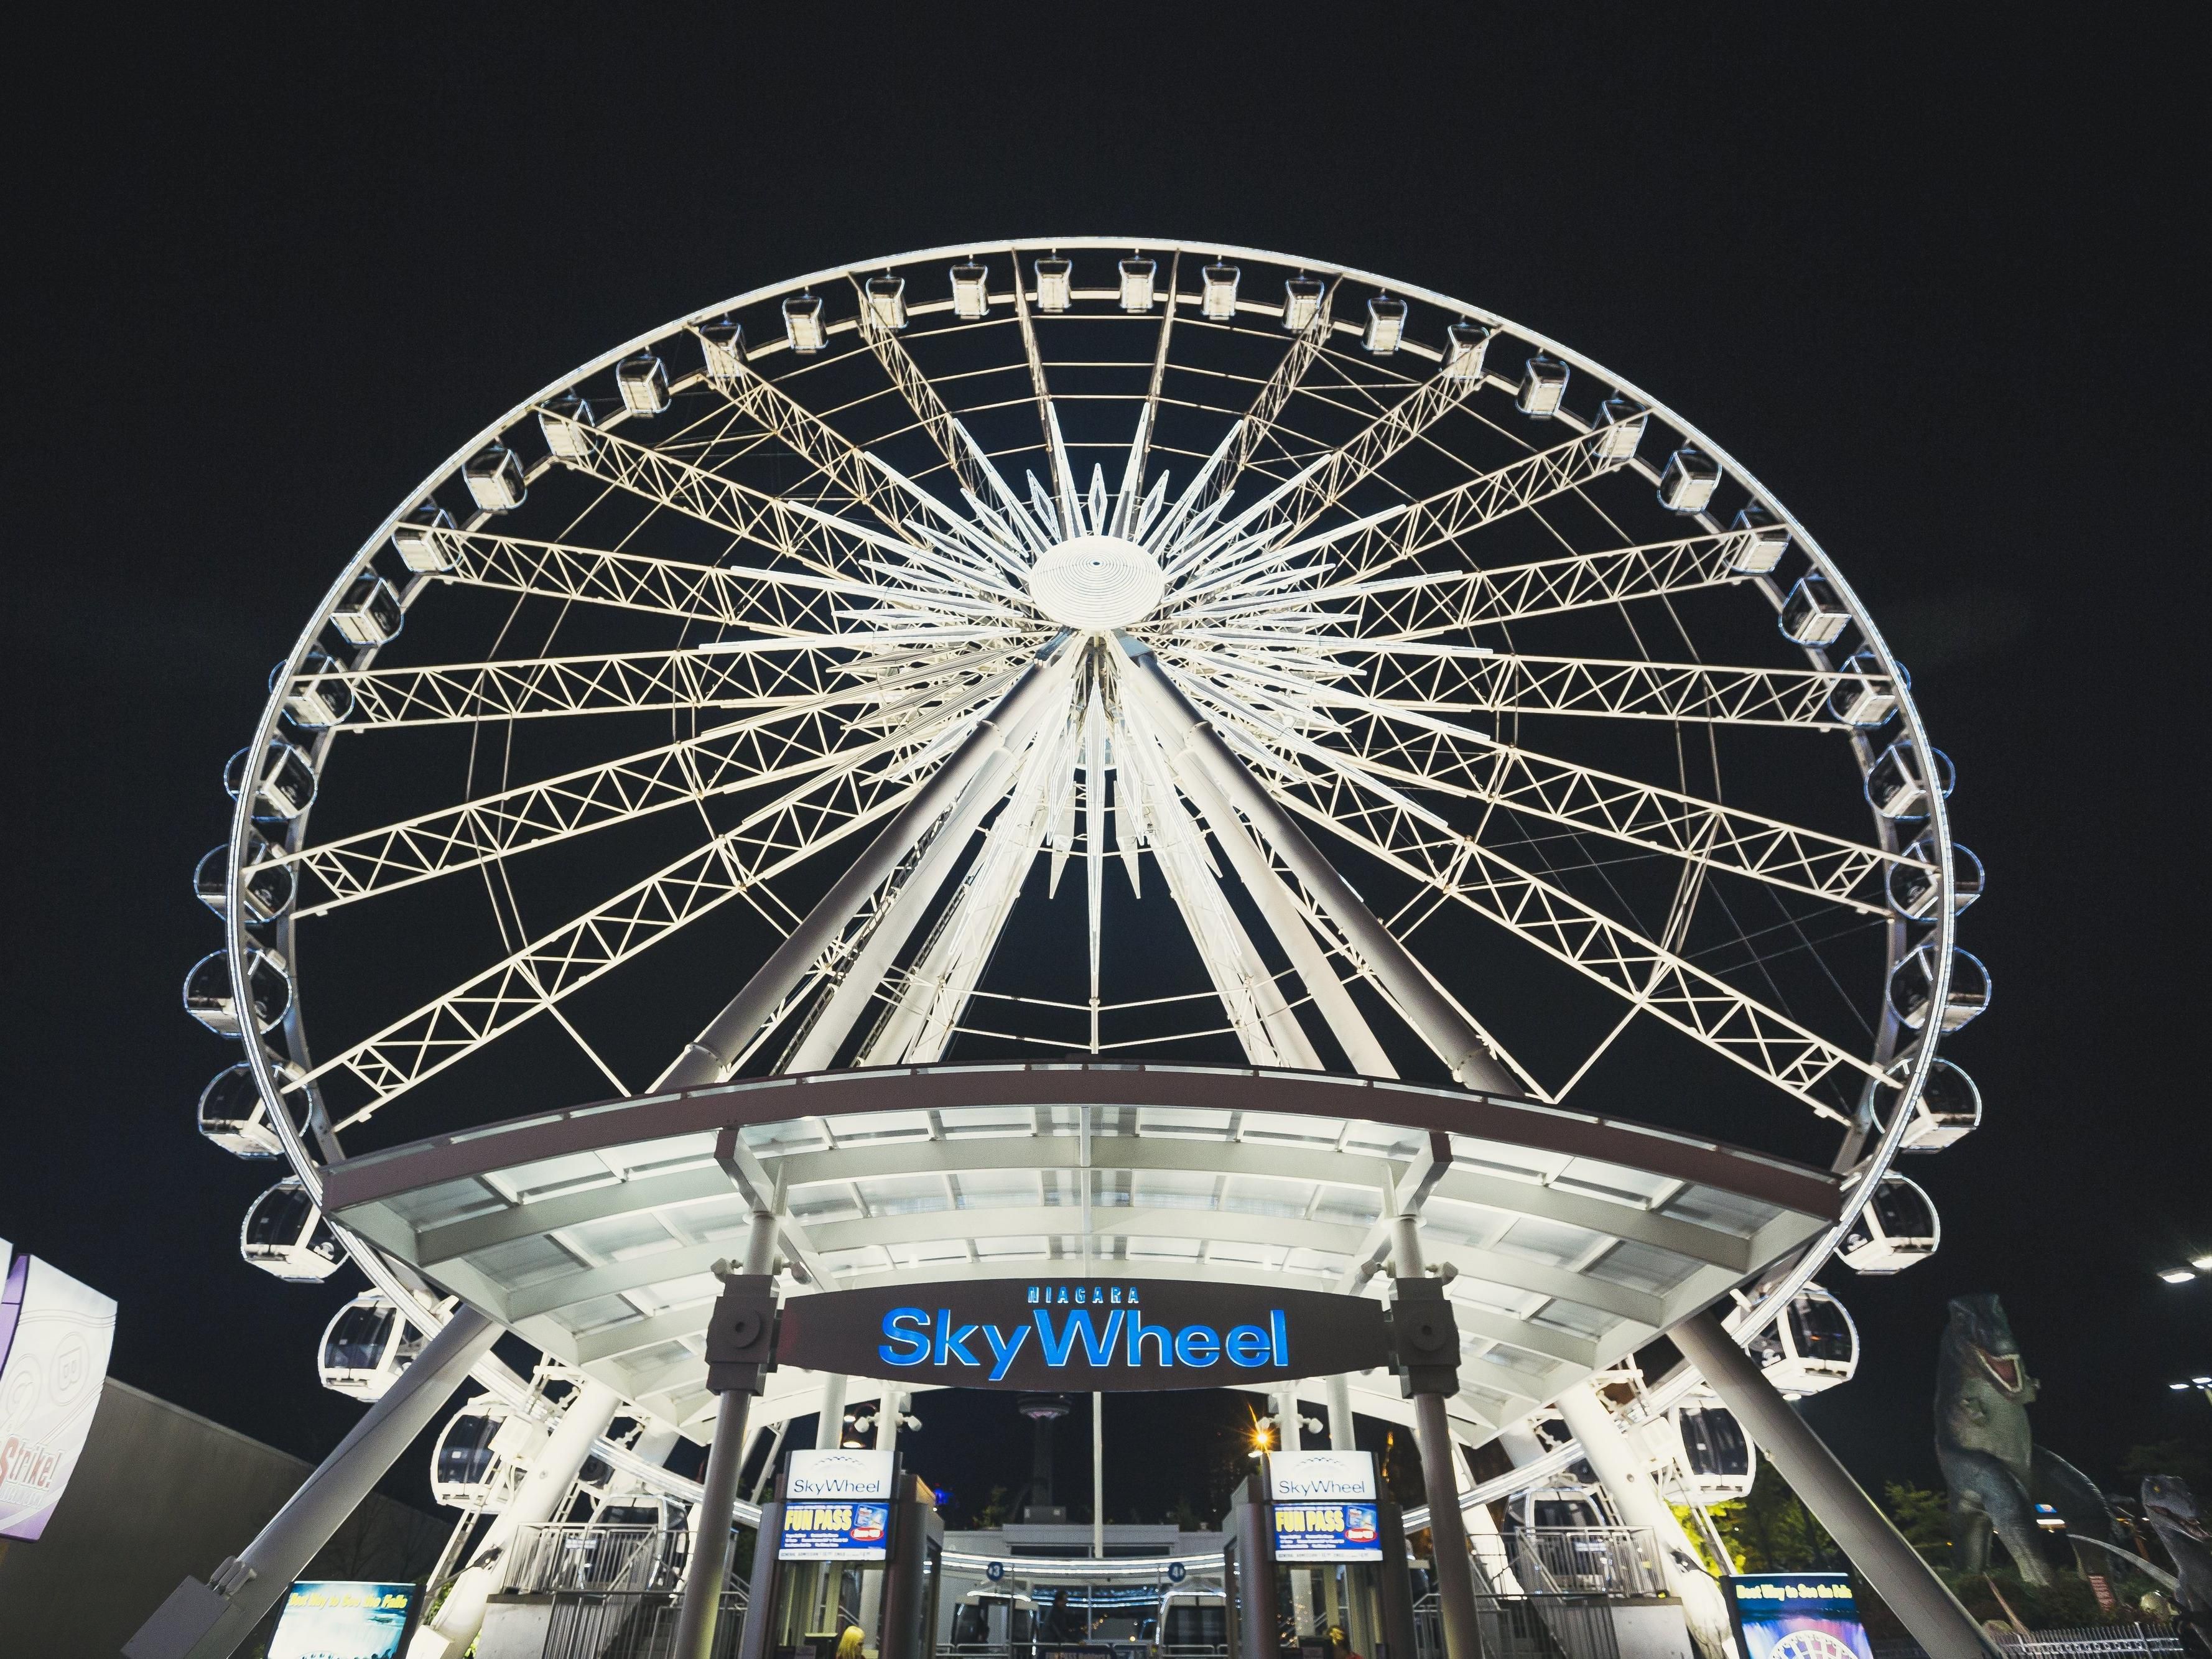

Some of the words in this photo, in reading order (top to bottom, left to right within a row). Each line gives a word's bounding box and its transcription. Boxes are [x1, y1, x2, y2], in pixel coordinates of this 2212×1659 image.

[1028, 1285, 1140, 1304] NIAGARA
[878, 1307, 1290, 1381] SkyWheel
[793, 1479, 880, 1495] SkyWheel
[1279, 1480, 1365, 1497] SkyWheel
[784, 1510, 814, 1531] FUN
[813, 1510, 853, 1531] PASS
[1276, 1511, 1306, 1532] FUN
[1306, 1511, 1345, 1532] PASS
[381, 1594, 408, 1609] Falls
